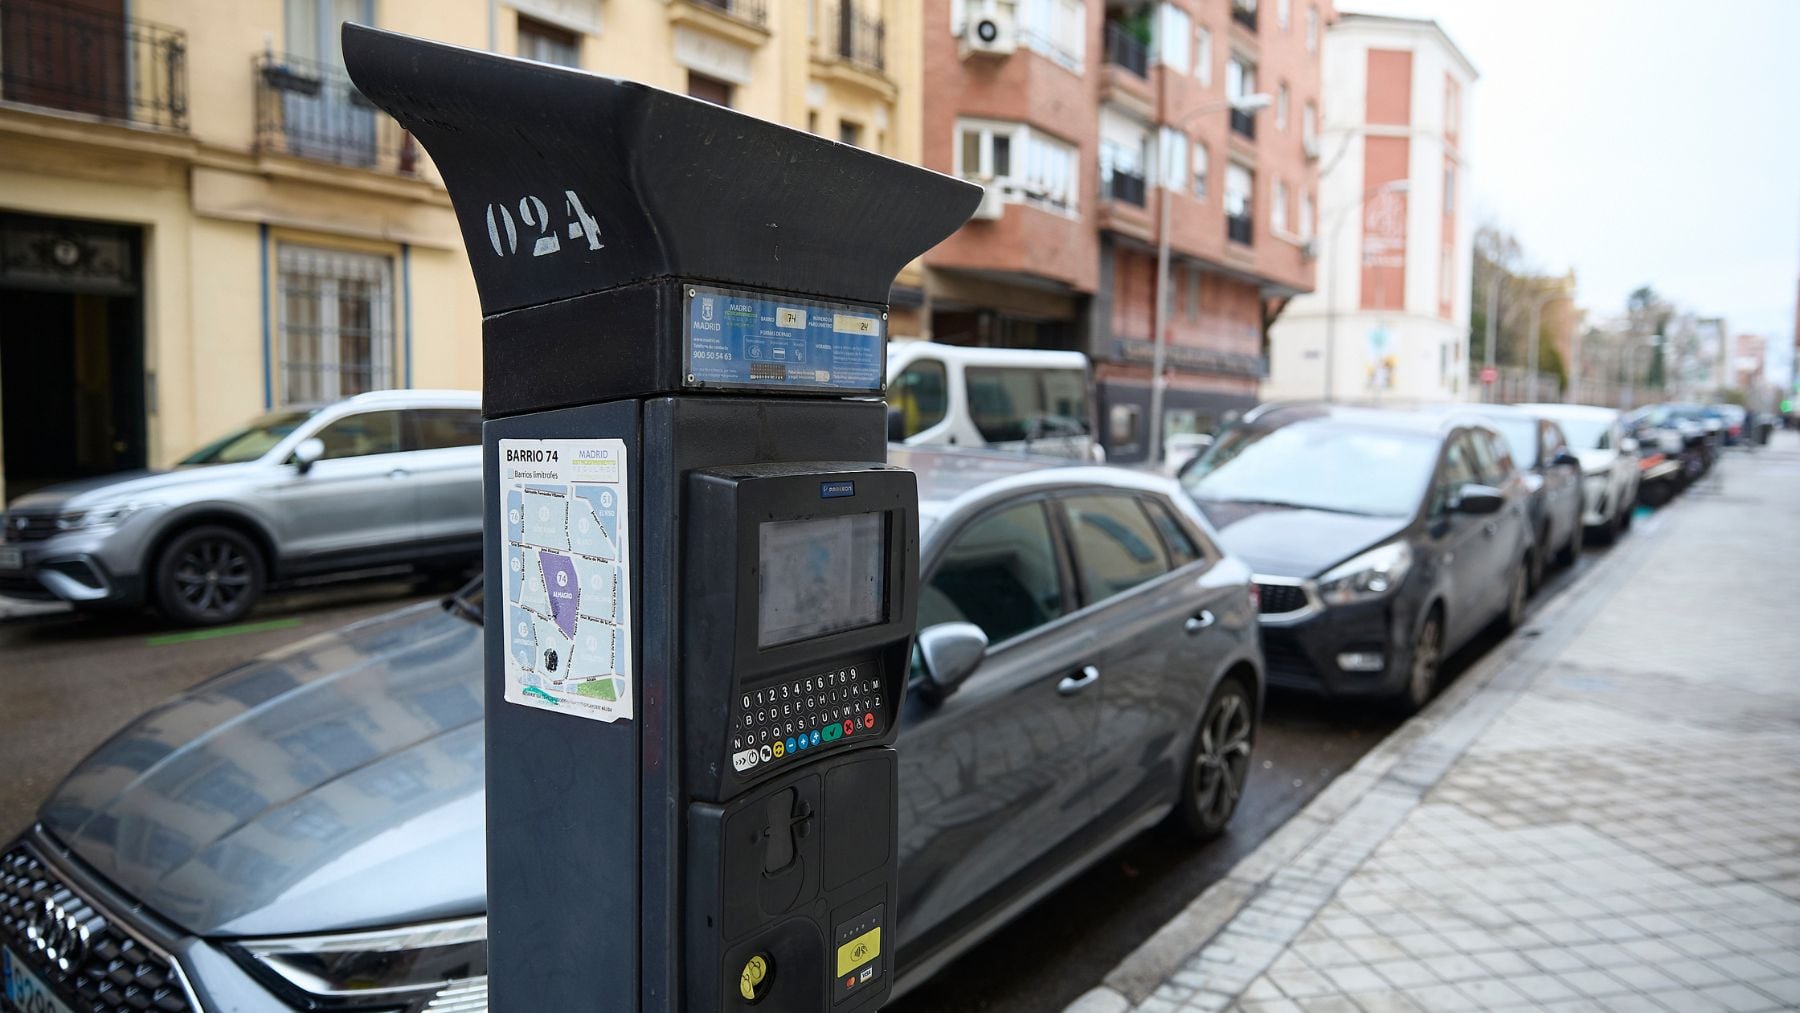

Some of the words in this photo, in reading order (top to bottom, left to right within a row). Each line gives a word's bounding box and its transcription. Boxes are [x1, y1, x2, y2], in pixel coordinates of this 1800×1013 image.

[486, 190, 605, 257] 024
[729, 304, 752, 312] MADRID
[788, 314, 796, 324] 74
[693, 321, 720, 331] MADRID
[860, 322, 869, 331] 24
[693, 351, 705, 359] 900
[706, 352, 714, 360] 50
[506, 449, 544, 462] BARRIO
[546, 450, 558, 462] 74
[578, 450, 608, 459] MADRID
[514, 470, 532, 479] Barrios
[558, 574, 566, 583] 74
[552, 591, 573, 600] ALMAGRO
[743, 696, 750, 708] 0
[756, 692, 763, 704] 1
[769, 690, 776, 702] 2
[781, 686, 789, 698] 3
[793, 684, 800, 694] 4
[805, 680, 812, 692] 5
[817, 678, 824, 688] 6
[828, 674, 834, 685] 7
[839, 672, 846, 682] 8
[850, 668, 856, 680] 9
